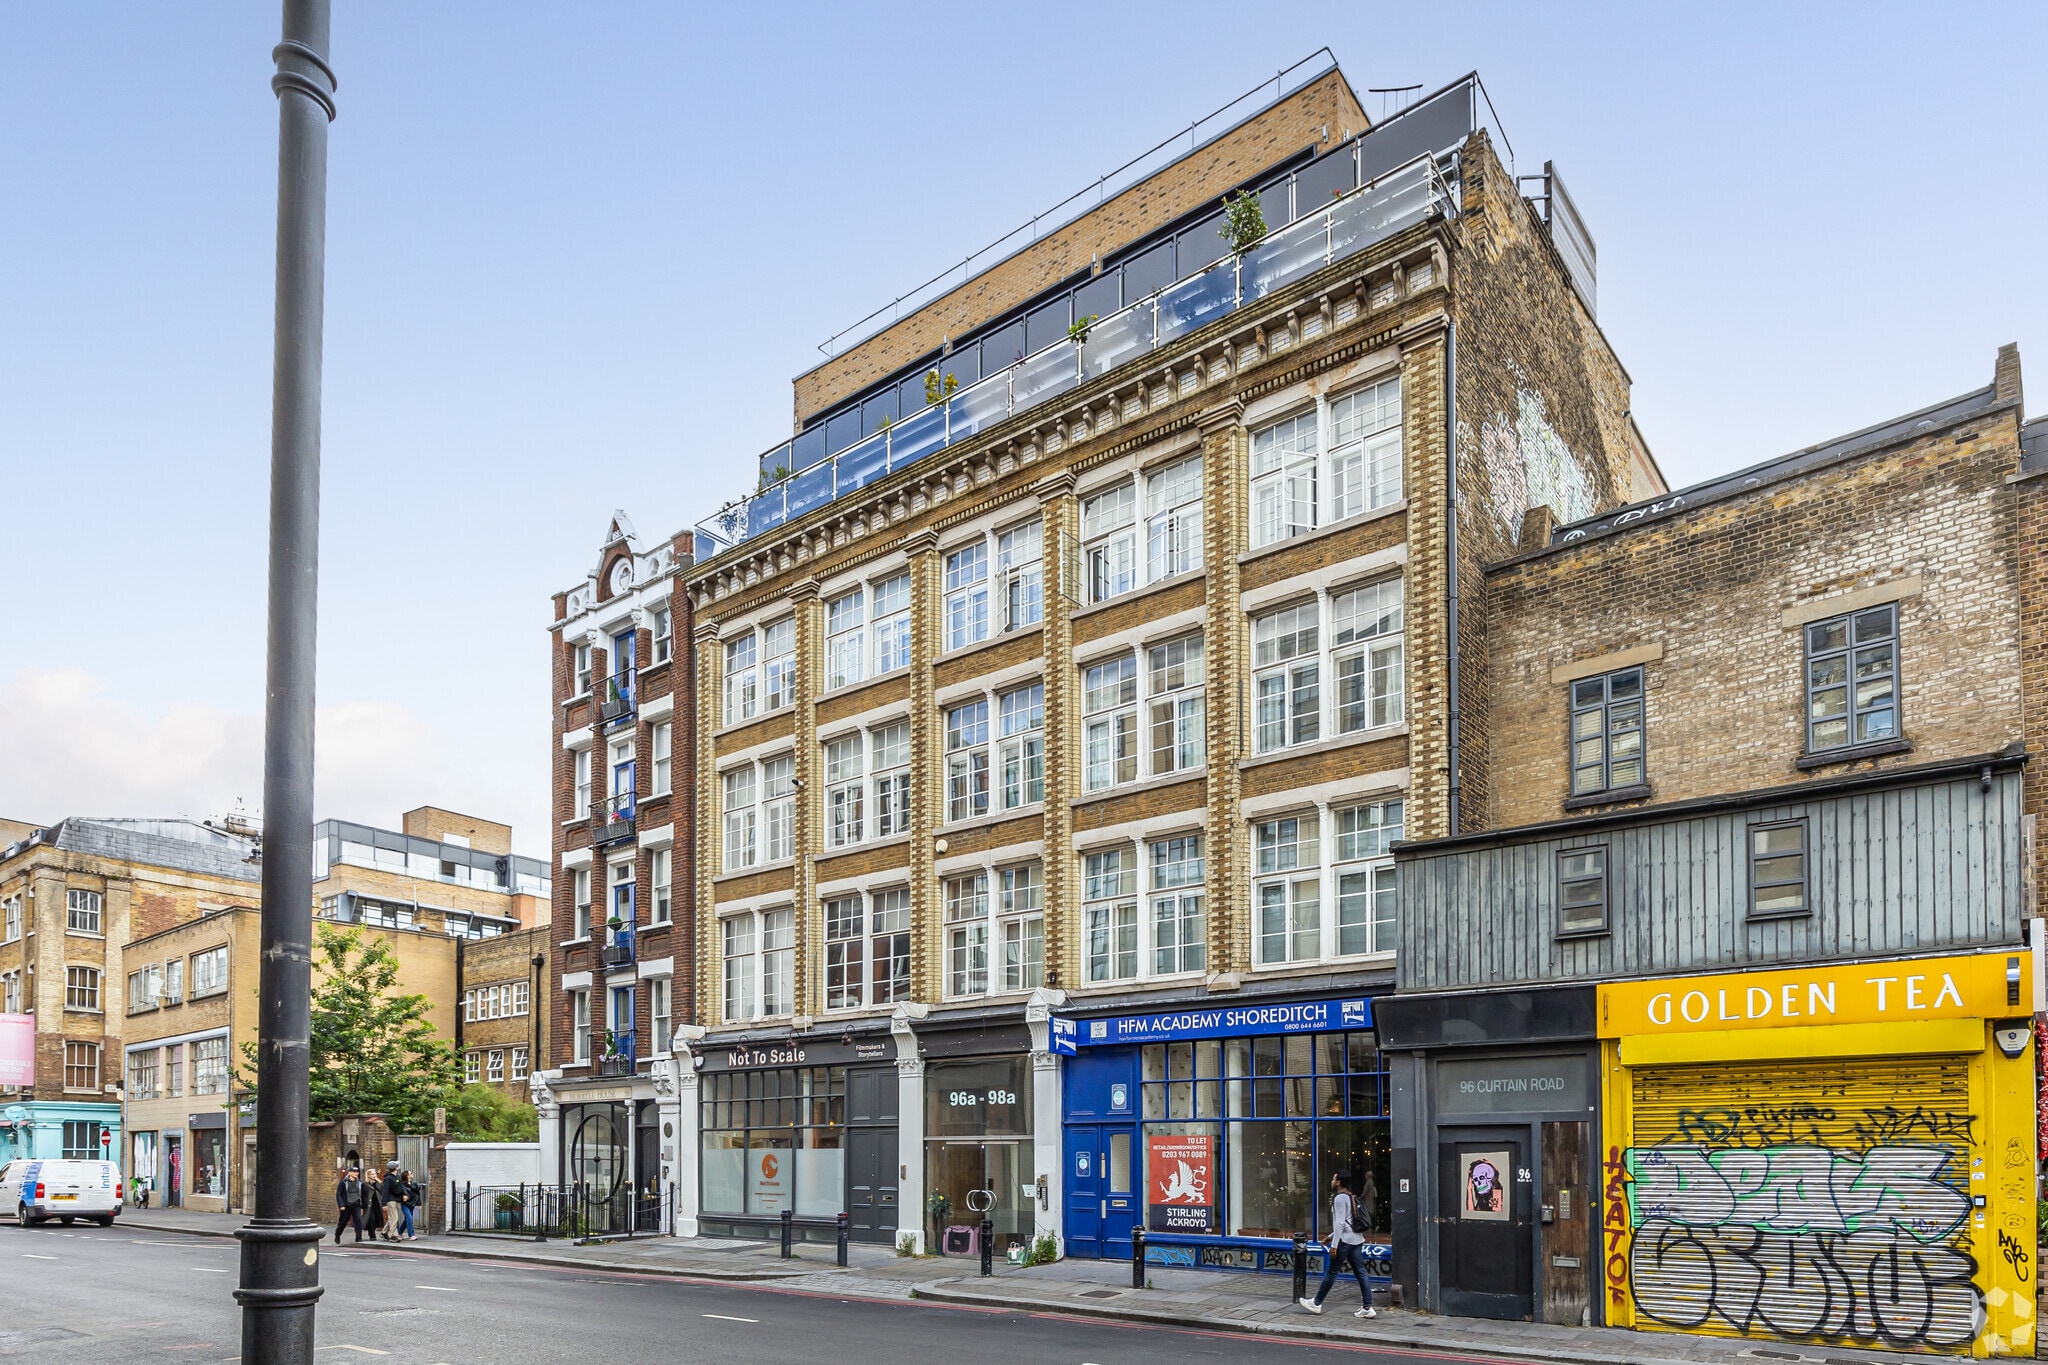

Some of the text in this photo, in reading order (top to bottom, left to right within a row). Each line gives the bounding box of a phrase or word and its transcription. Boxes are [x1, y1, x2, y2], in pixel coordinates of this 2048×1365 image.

[1647, 973, 1964, 1025] GOLDEN TEA
[1118, 1018, 1148, 1034] HFM
[1151, 1012, 1222, 1032] ACADEMY
[1226, 1004, 1328, 1027] SHOREDITCH
[1284, 1023, 1300, 1031] 0800
[1313, 1021, 1328, 1029] 6601
[728, 1047, 806, 1067] Not To Scale
[1460, 1077, 1565, 1093] 96 CURTAIN ROAD
[949, 1091, 977, 1106] 96a
[987, 1089, 1016, 1105] 98a
[100, 1164, 110, 1189] Initial
[1518, 1168, 1531, 1179] 96
[1167, 1208, 1207, 1217] STIRLING
[1167, 1218, 1207, 1228] ACKROYD
